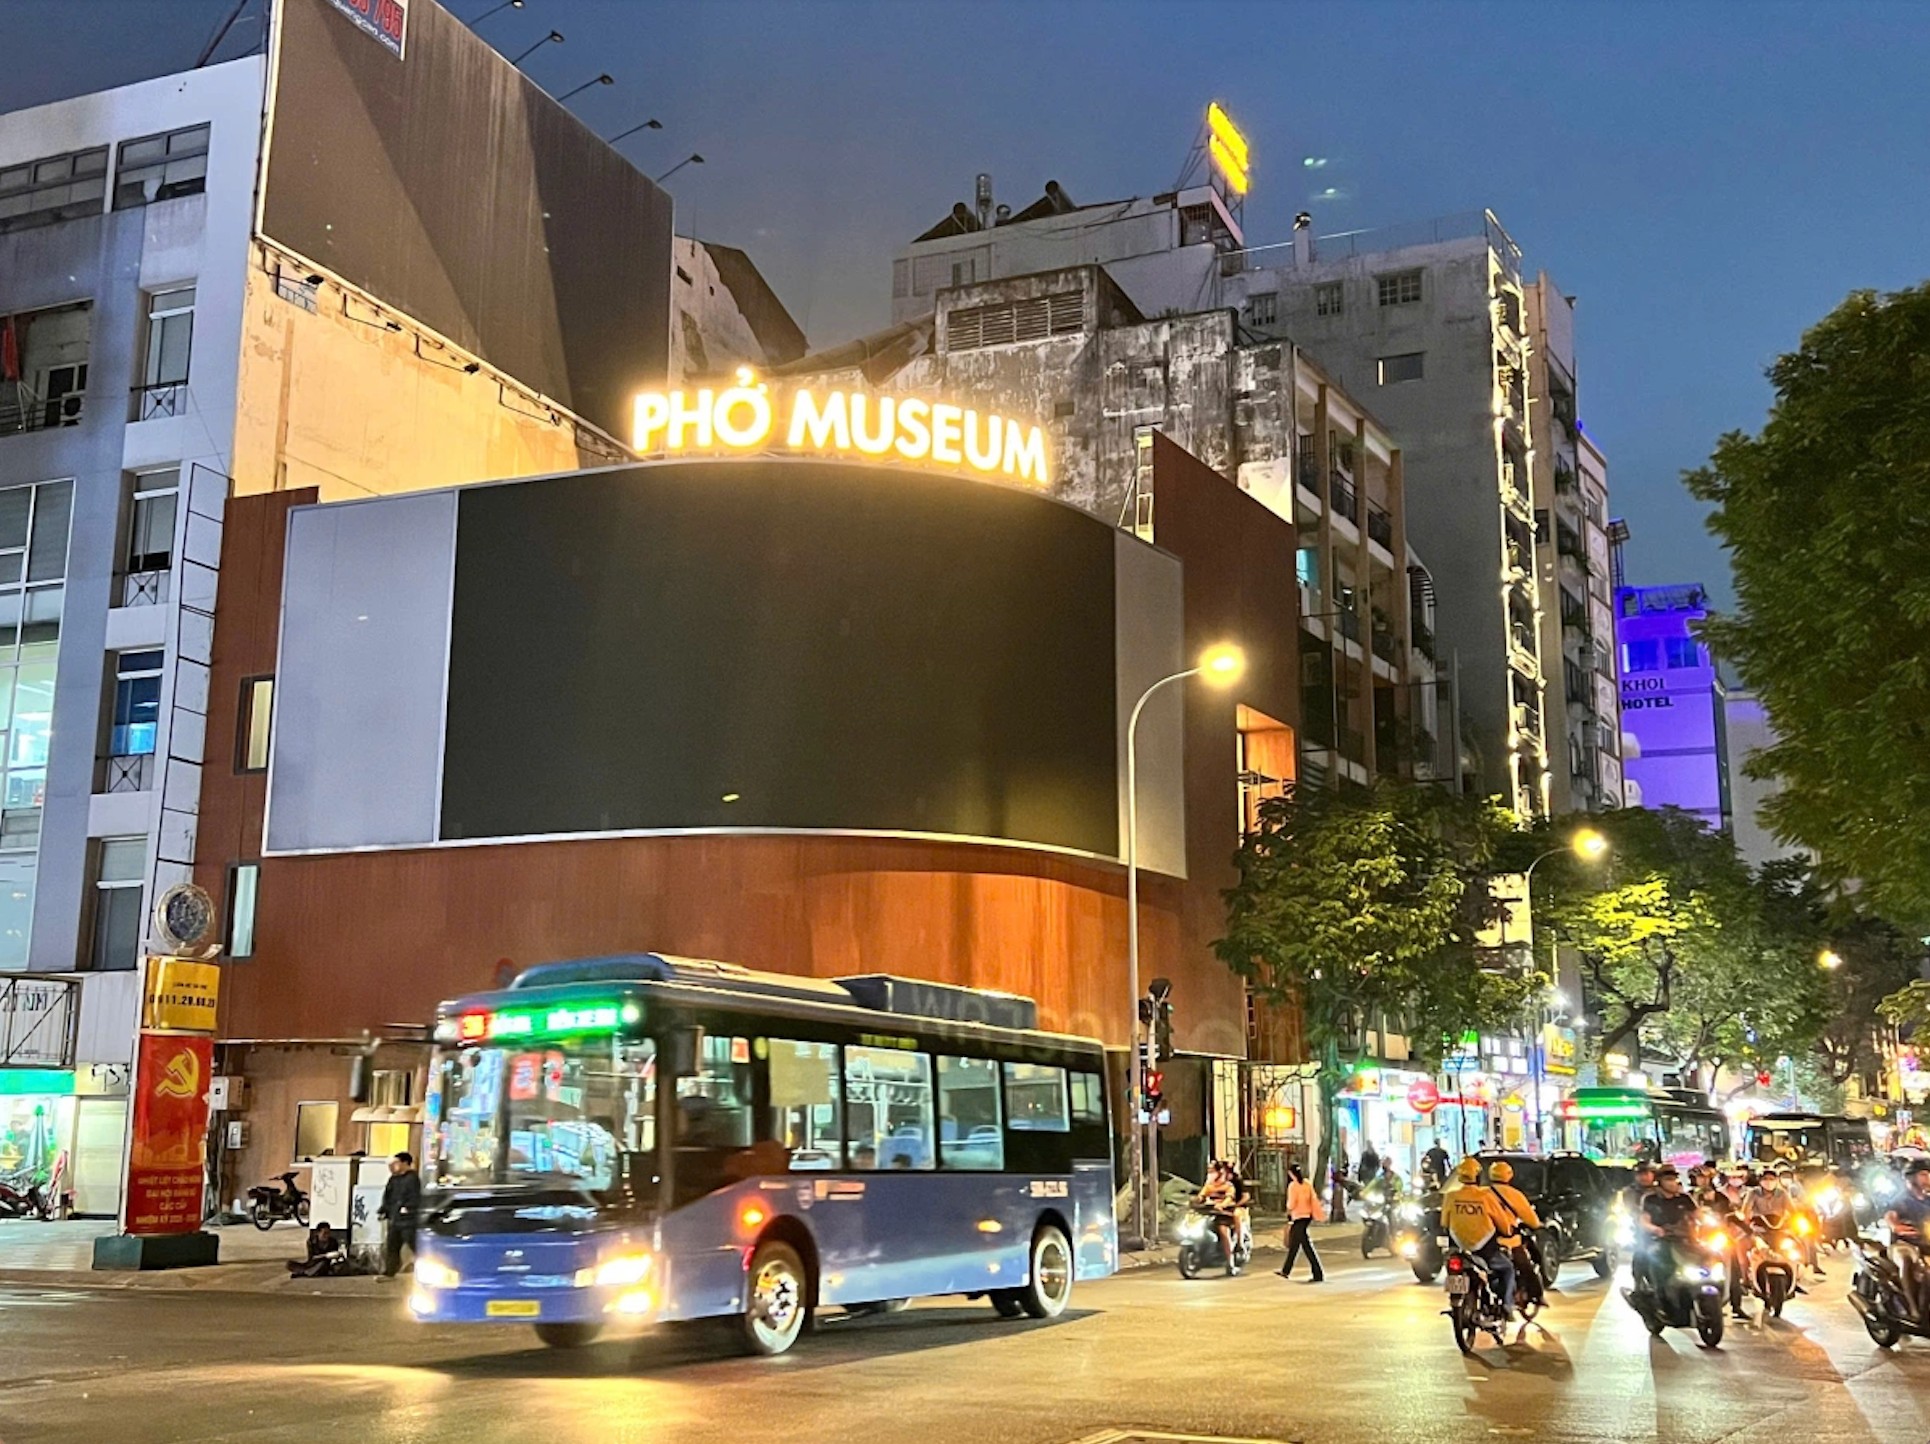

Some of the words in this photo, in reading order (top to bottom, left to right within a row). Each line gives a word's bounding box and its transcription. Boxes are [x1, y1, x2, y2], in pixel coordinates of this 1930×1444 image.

[632, 365, 772, 452] PHỞ
[787, 388, 1048, 483] MUSEUM
[1621, 696, 1674, 710] HOTEL
